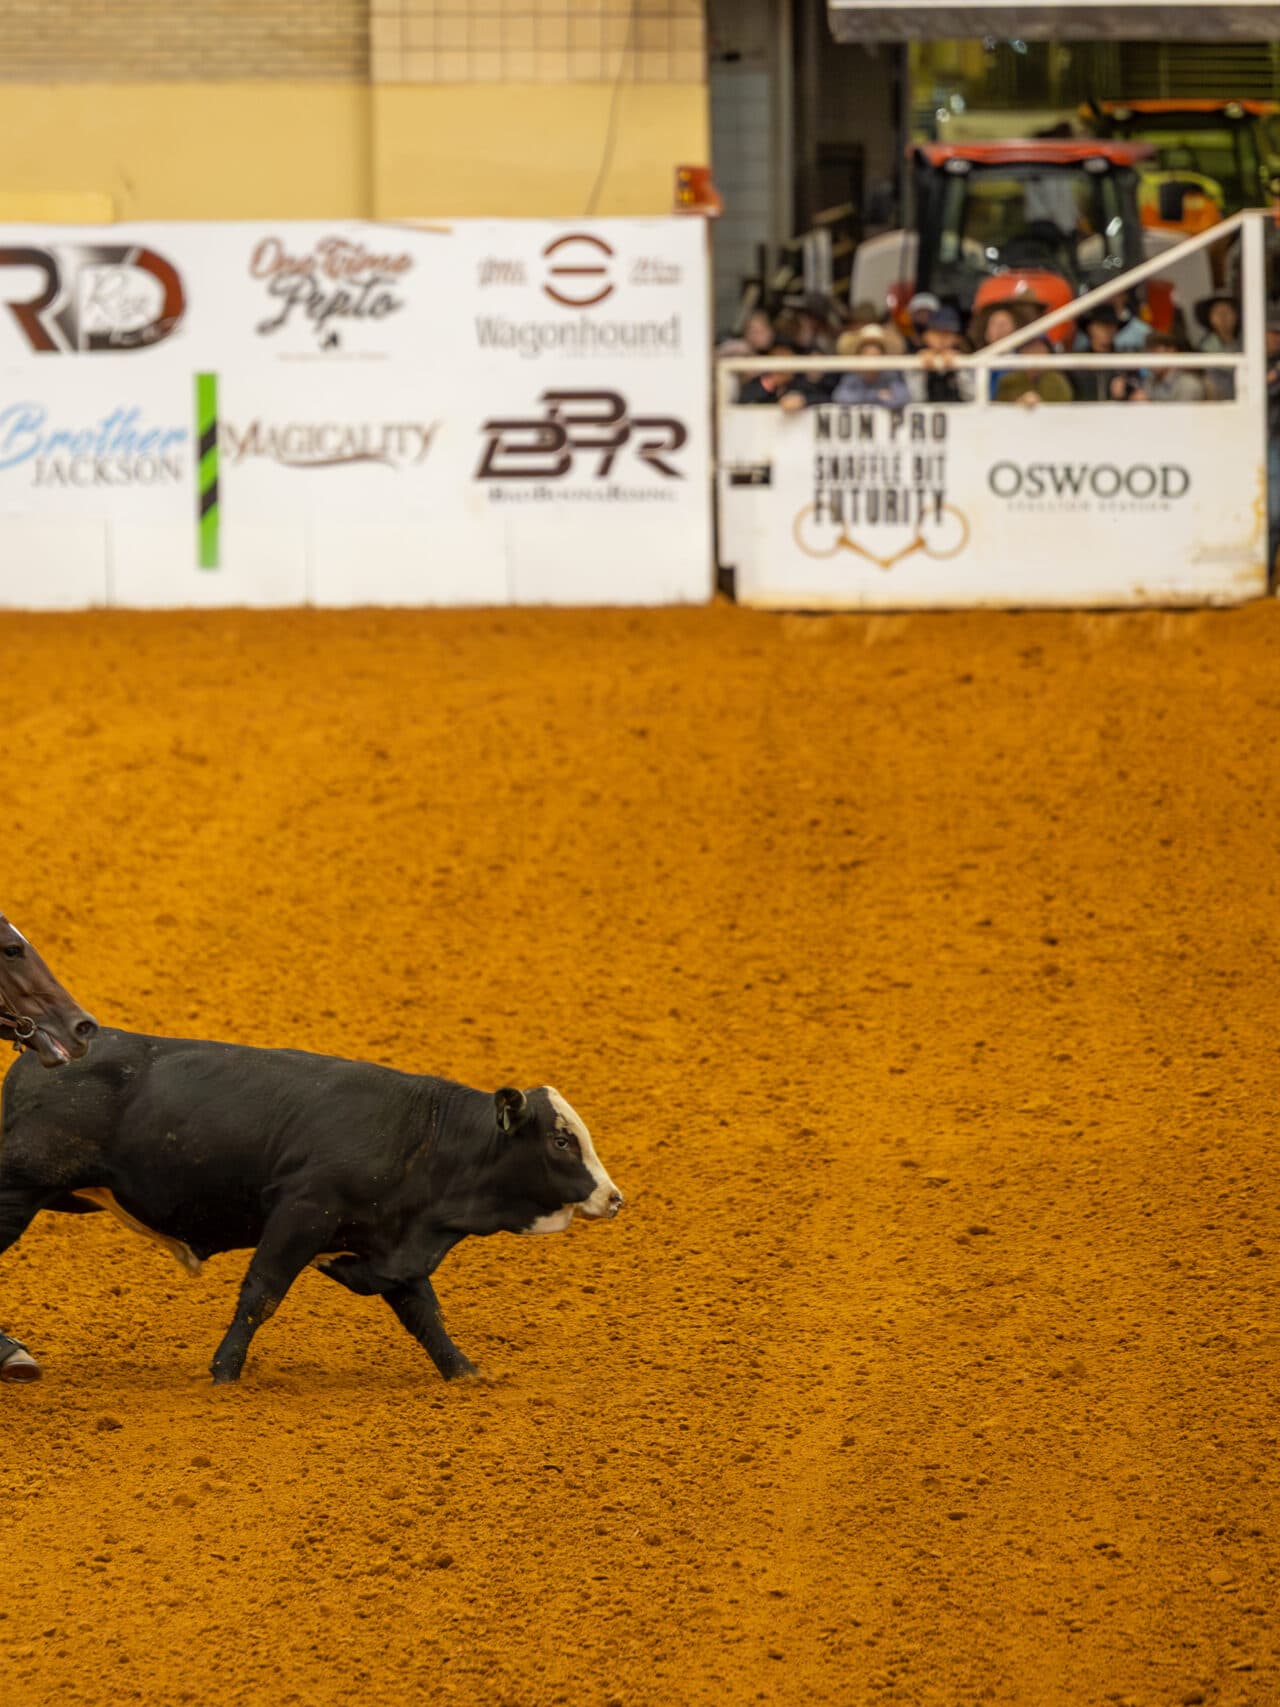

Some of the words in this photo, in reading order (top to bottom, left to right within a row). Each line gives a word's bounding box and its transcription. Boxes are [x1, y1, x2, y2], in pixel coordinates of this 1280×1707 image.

[255, 272, 406, 335] Pepto
[474, 312, 682, 359] Wagonhound
[815, 410, 874, 440] NON
[890, 408, 947, 440] PRO
[31, 451, 183, 488] JACKSON
[987, 459, 1191, 499] OSWOOD
[814, 487, 947, 525] FUTURITY
